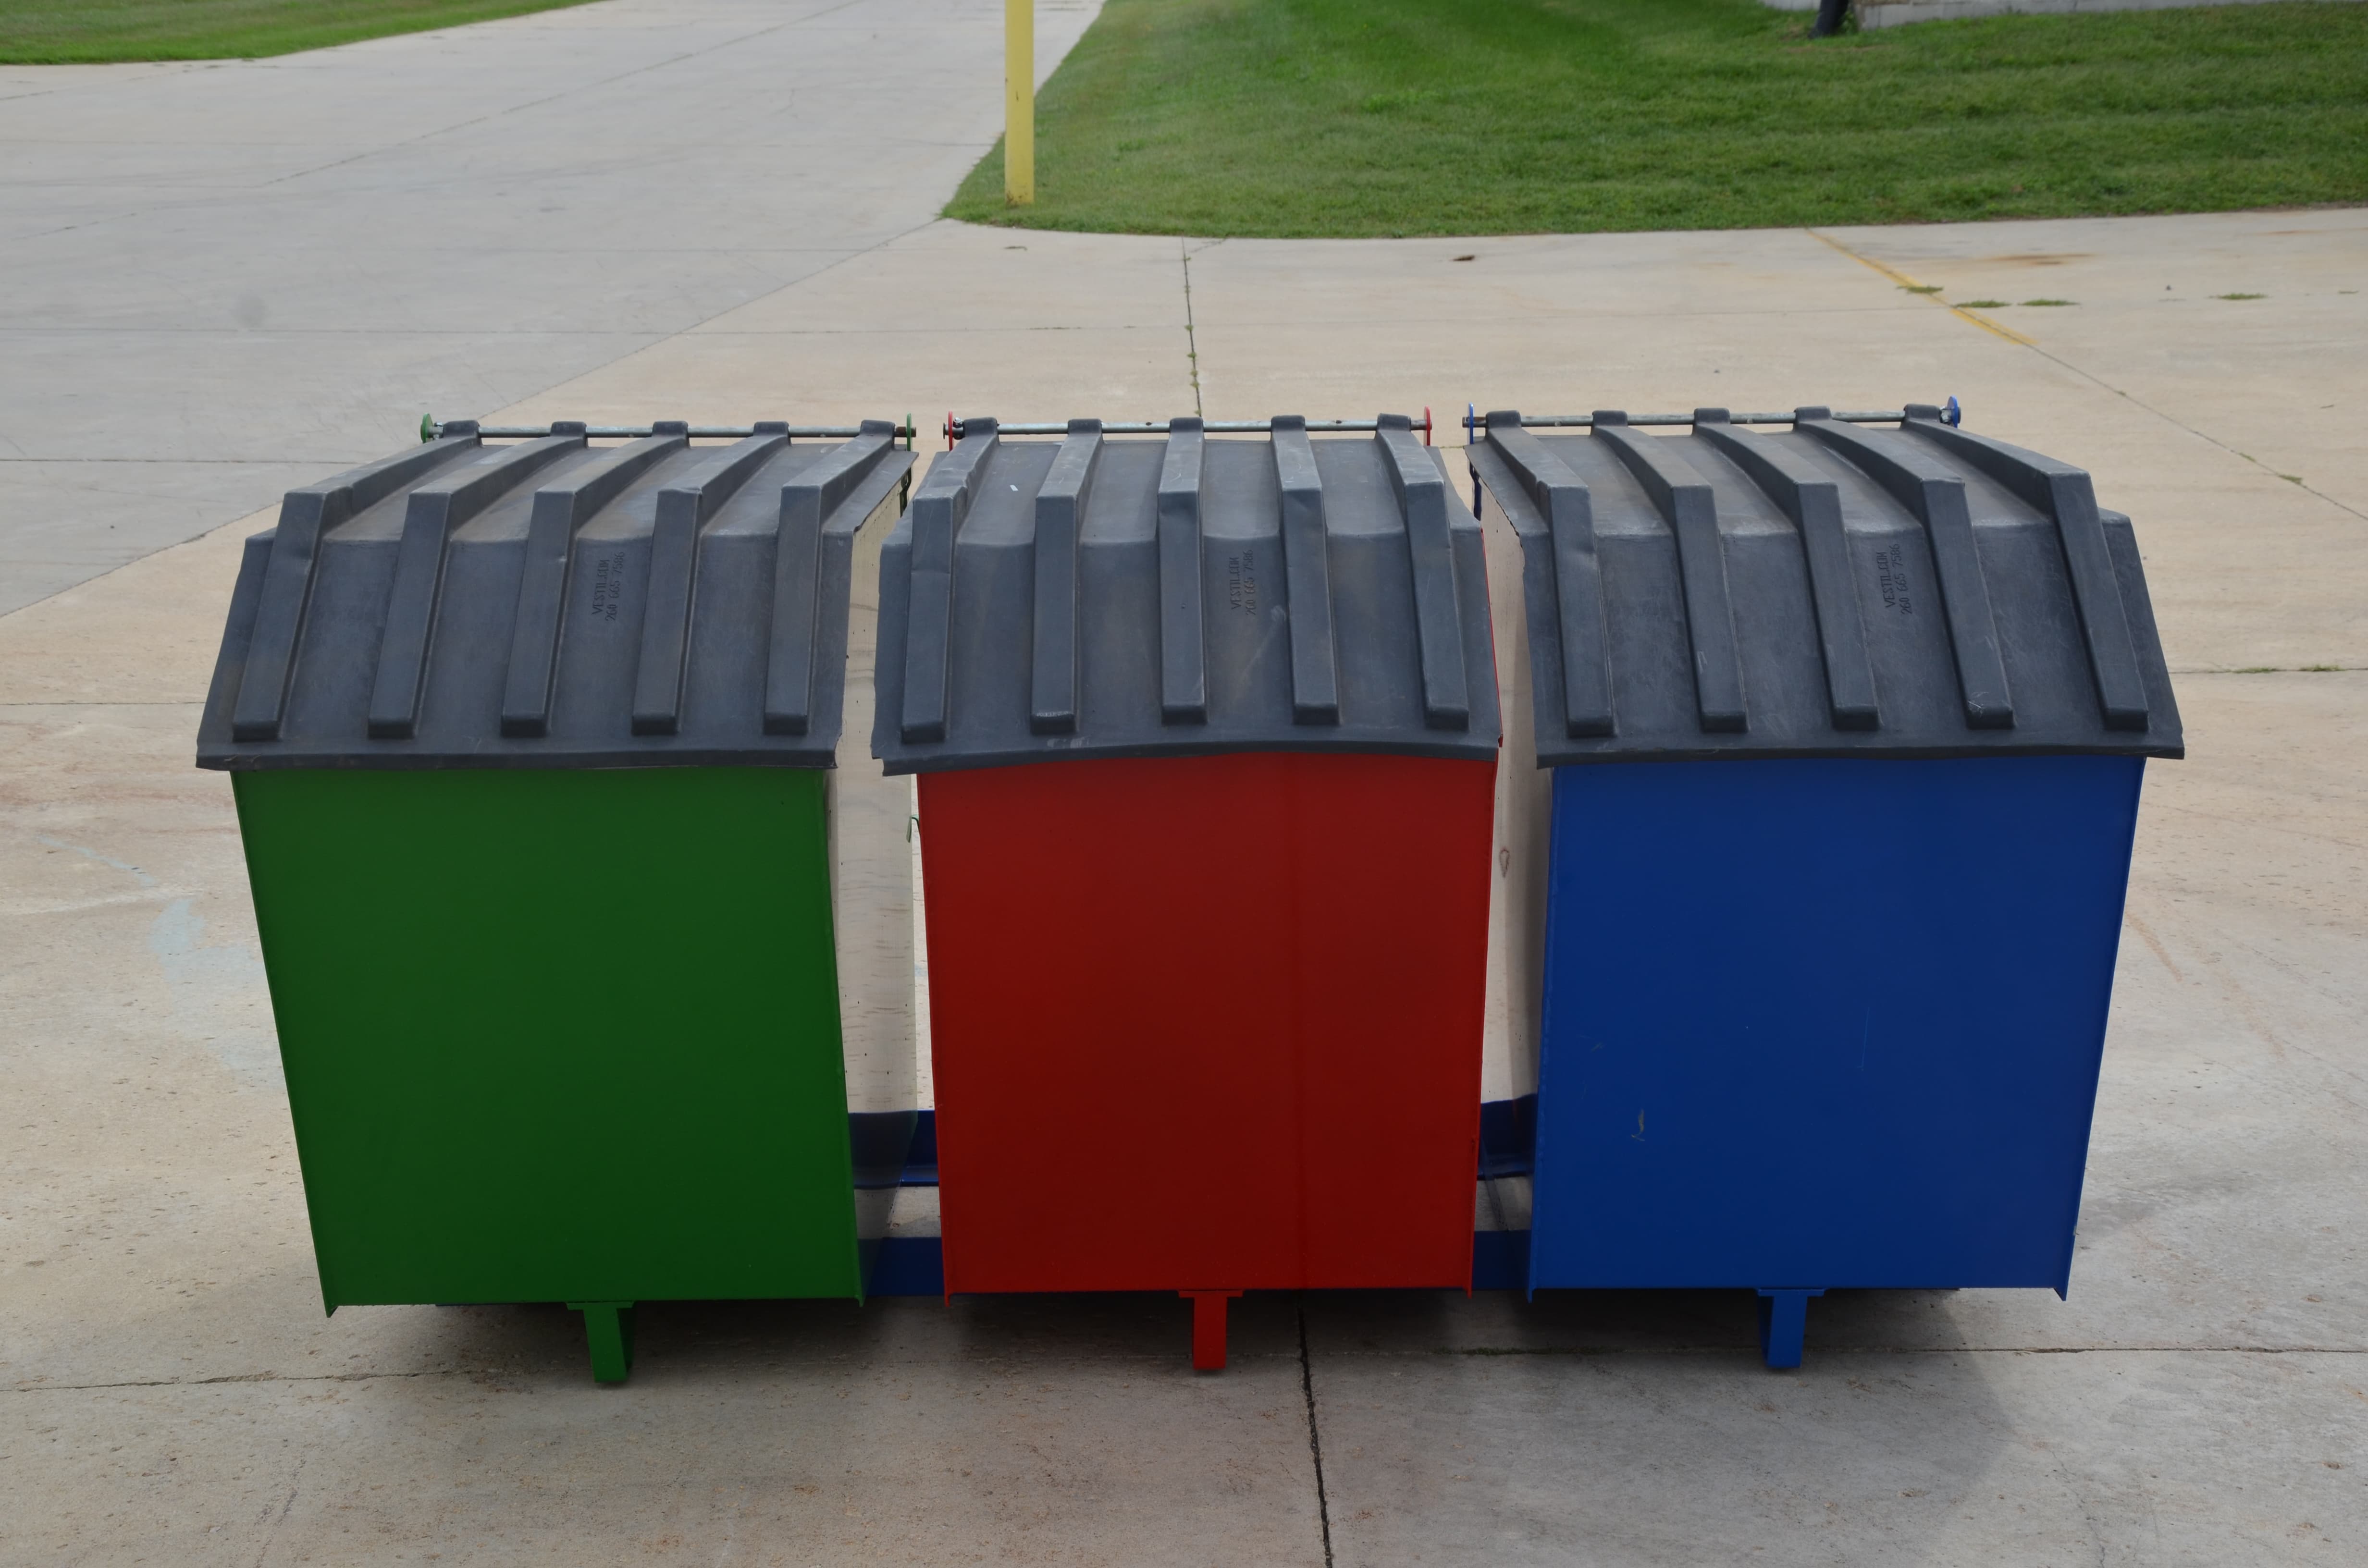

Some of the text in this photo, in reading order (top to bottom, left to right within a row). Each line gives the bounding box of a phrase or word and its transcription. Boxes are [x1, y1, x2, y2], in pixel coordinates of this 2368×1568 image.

[604, 551, 625, 621] 260 665 7586
[1244, 577, 1255, 594] 665
[1876, 551, 1896, 608] VESTIL.COM
[1889, 543, 1912, 614] 260 665 7586
